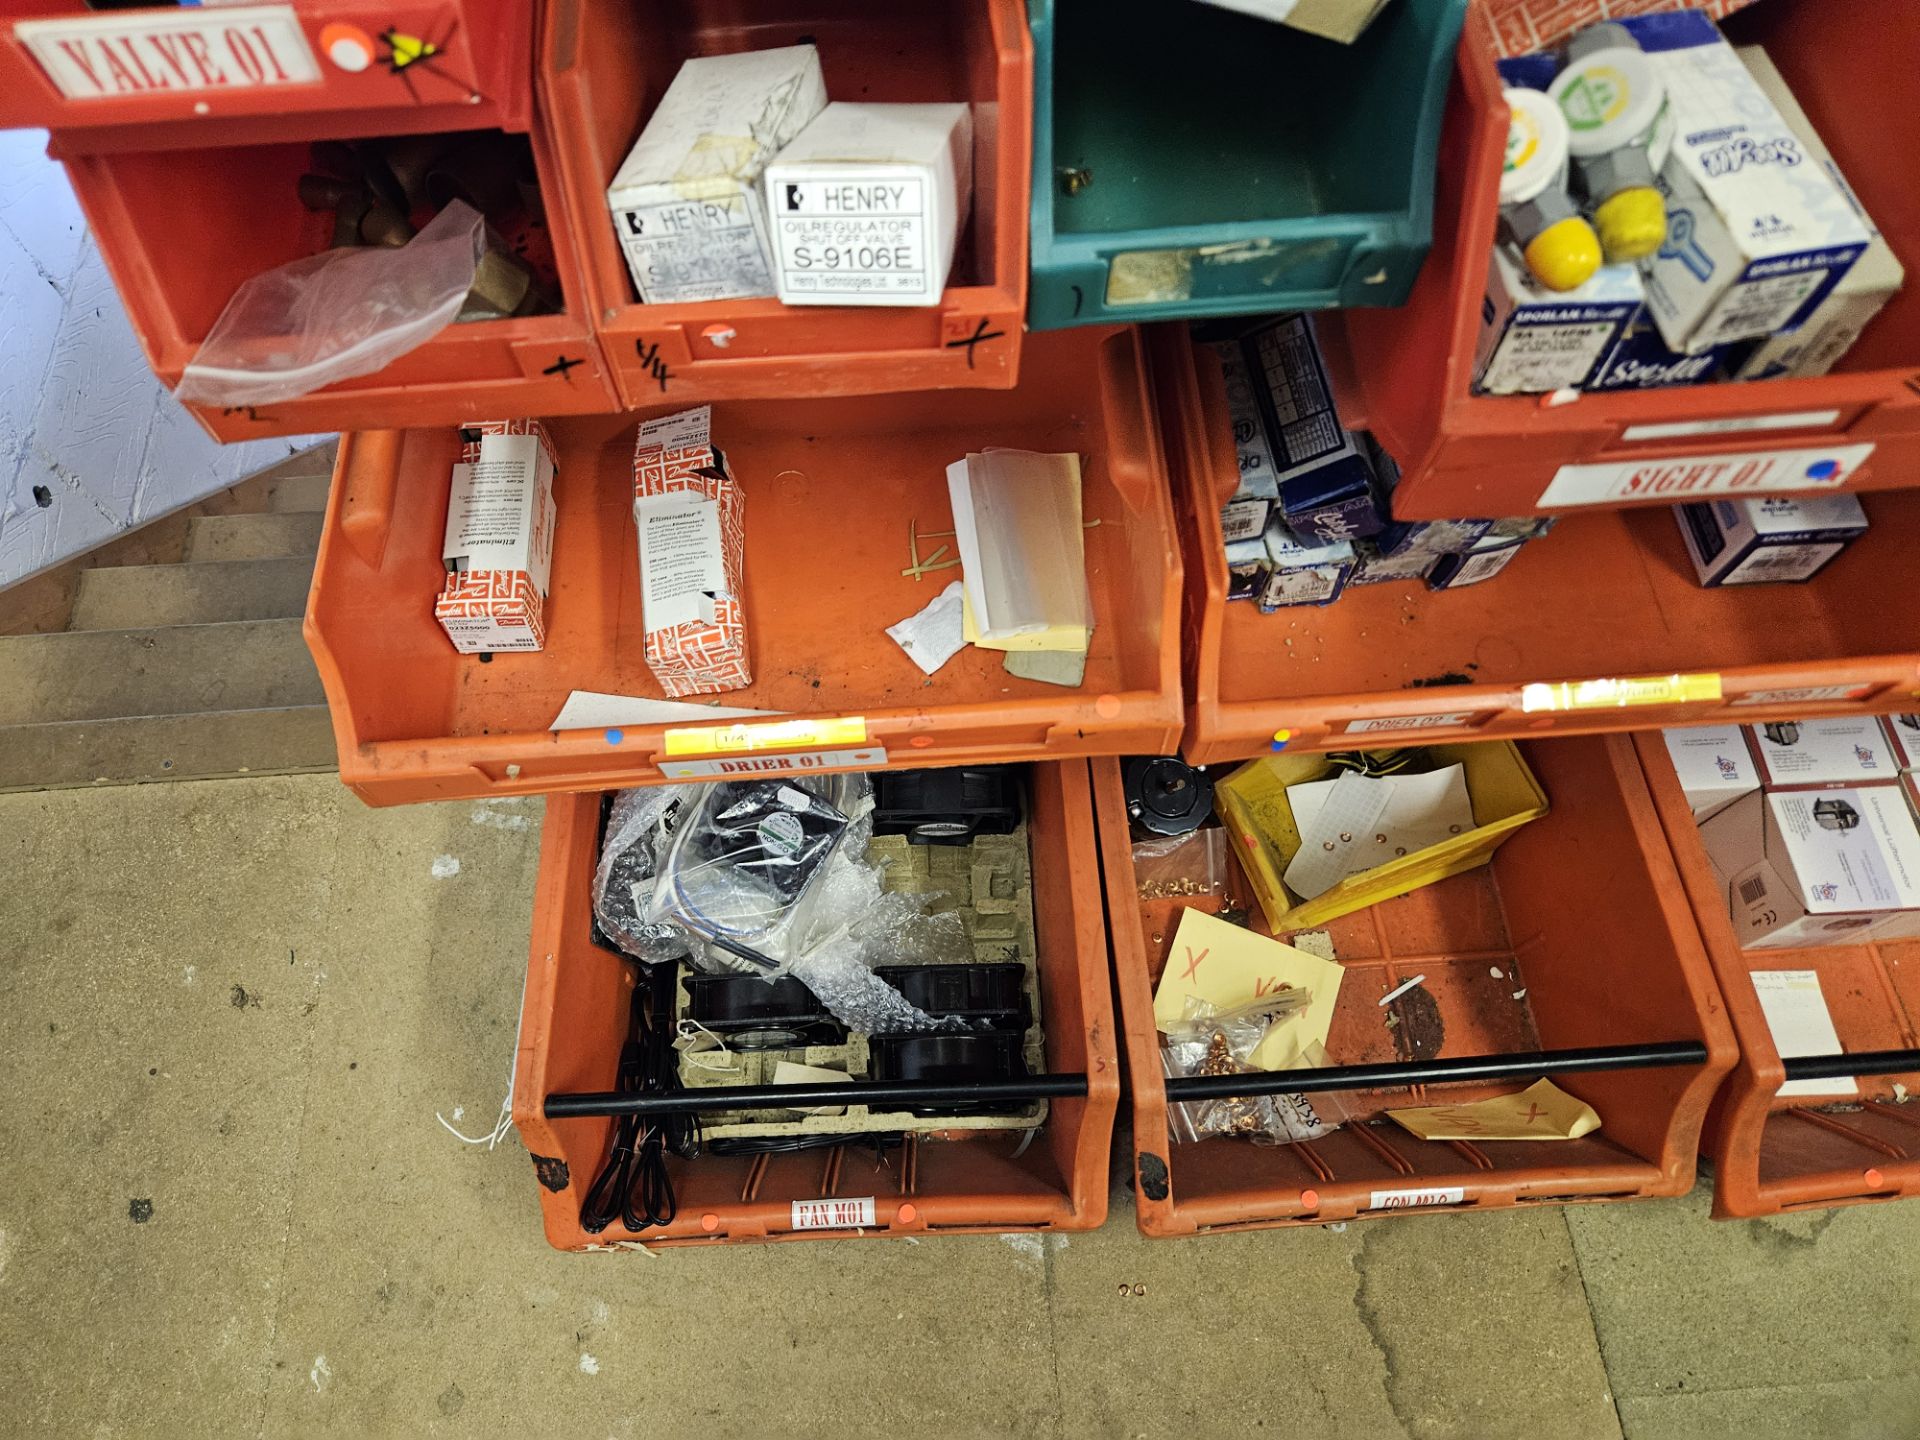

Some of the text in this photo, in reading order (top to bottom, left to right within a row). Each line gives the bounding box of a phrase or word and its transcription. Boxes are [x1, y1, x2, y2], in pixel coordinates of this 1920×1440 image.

[58, 26, 289, 92] VALVE 01
[825, 186, 904, 211] HENRY
[660, 201, 733, 232] HENRY
[793, 245, 913, 270] S-9106E
[1621, 458, 1776, 496] SIGHT 01
[720, 756, 825, 773] DRIER 01
[799, 1201, 865, 1227] FAN M01
